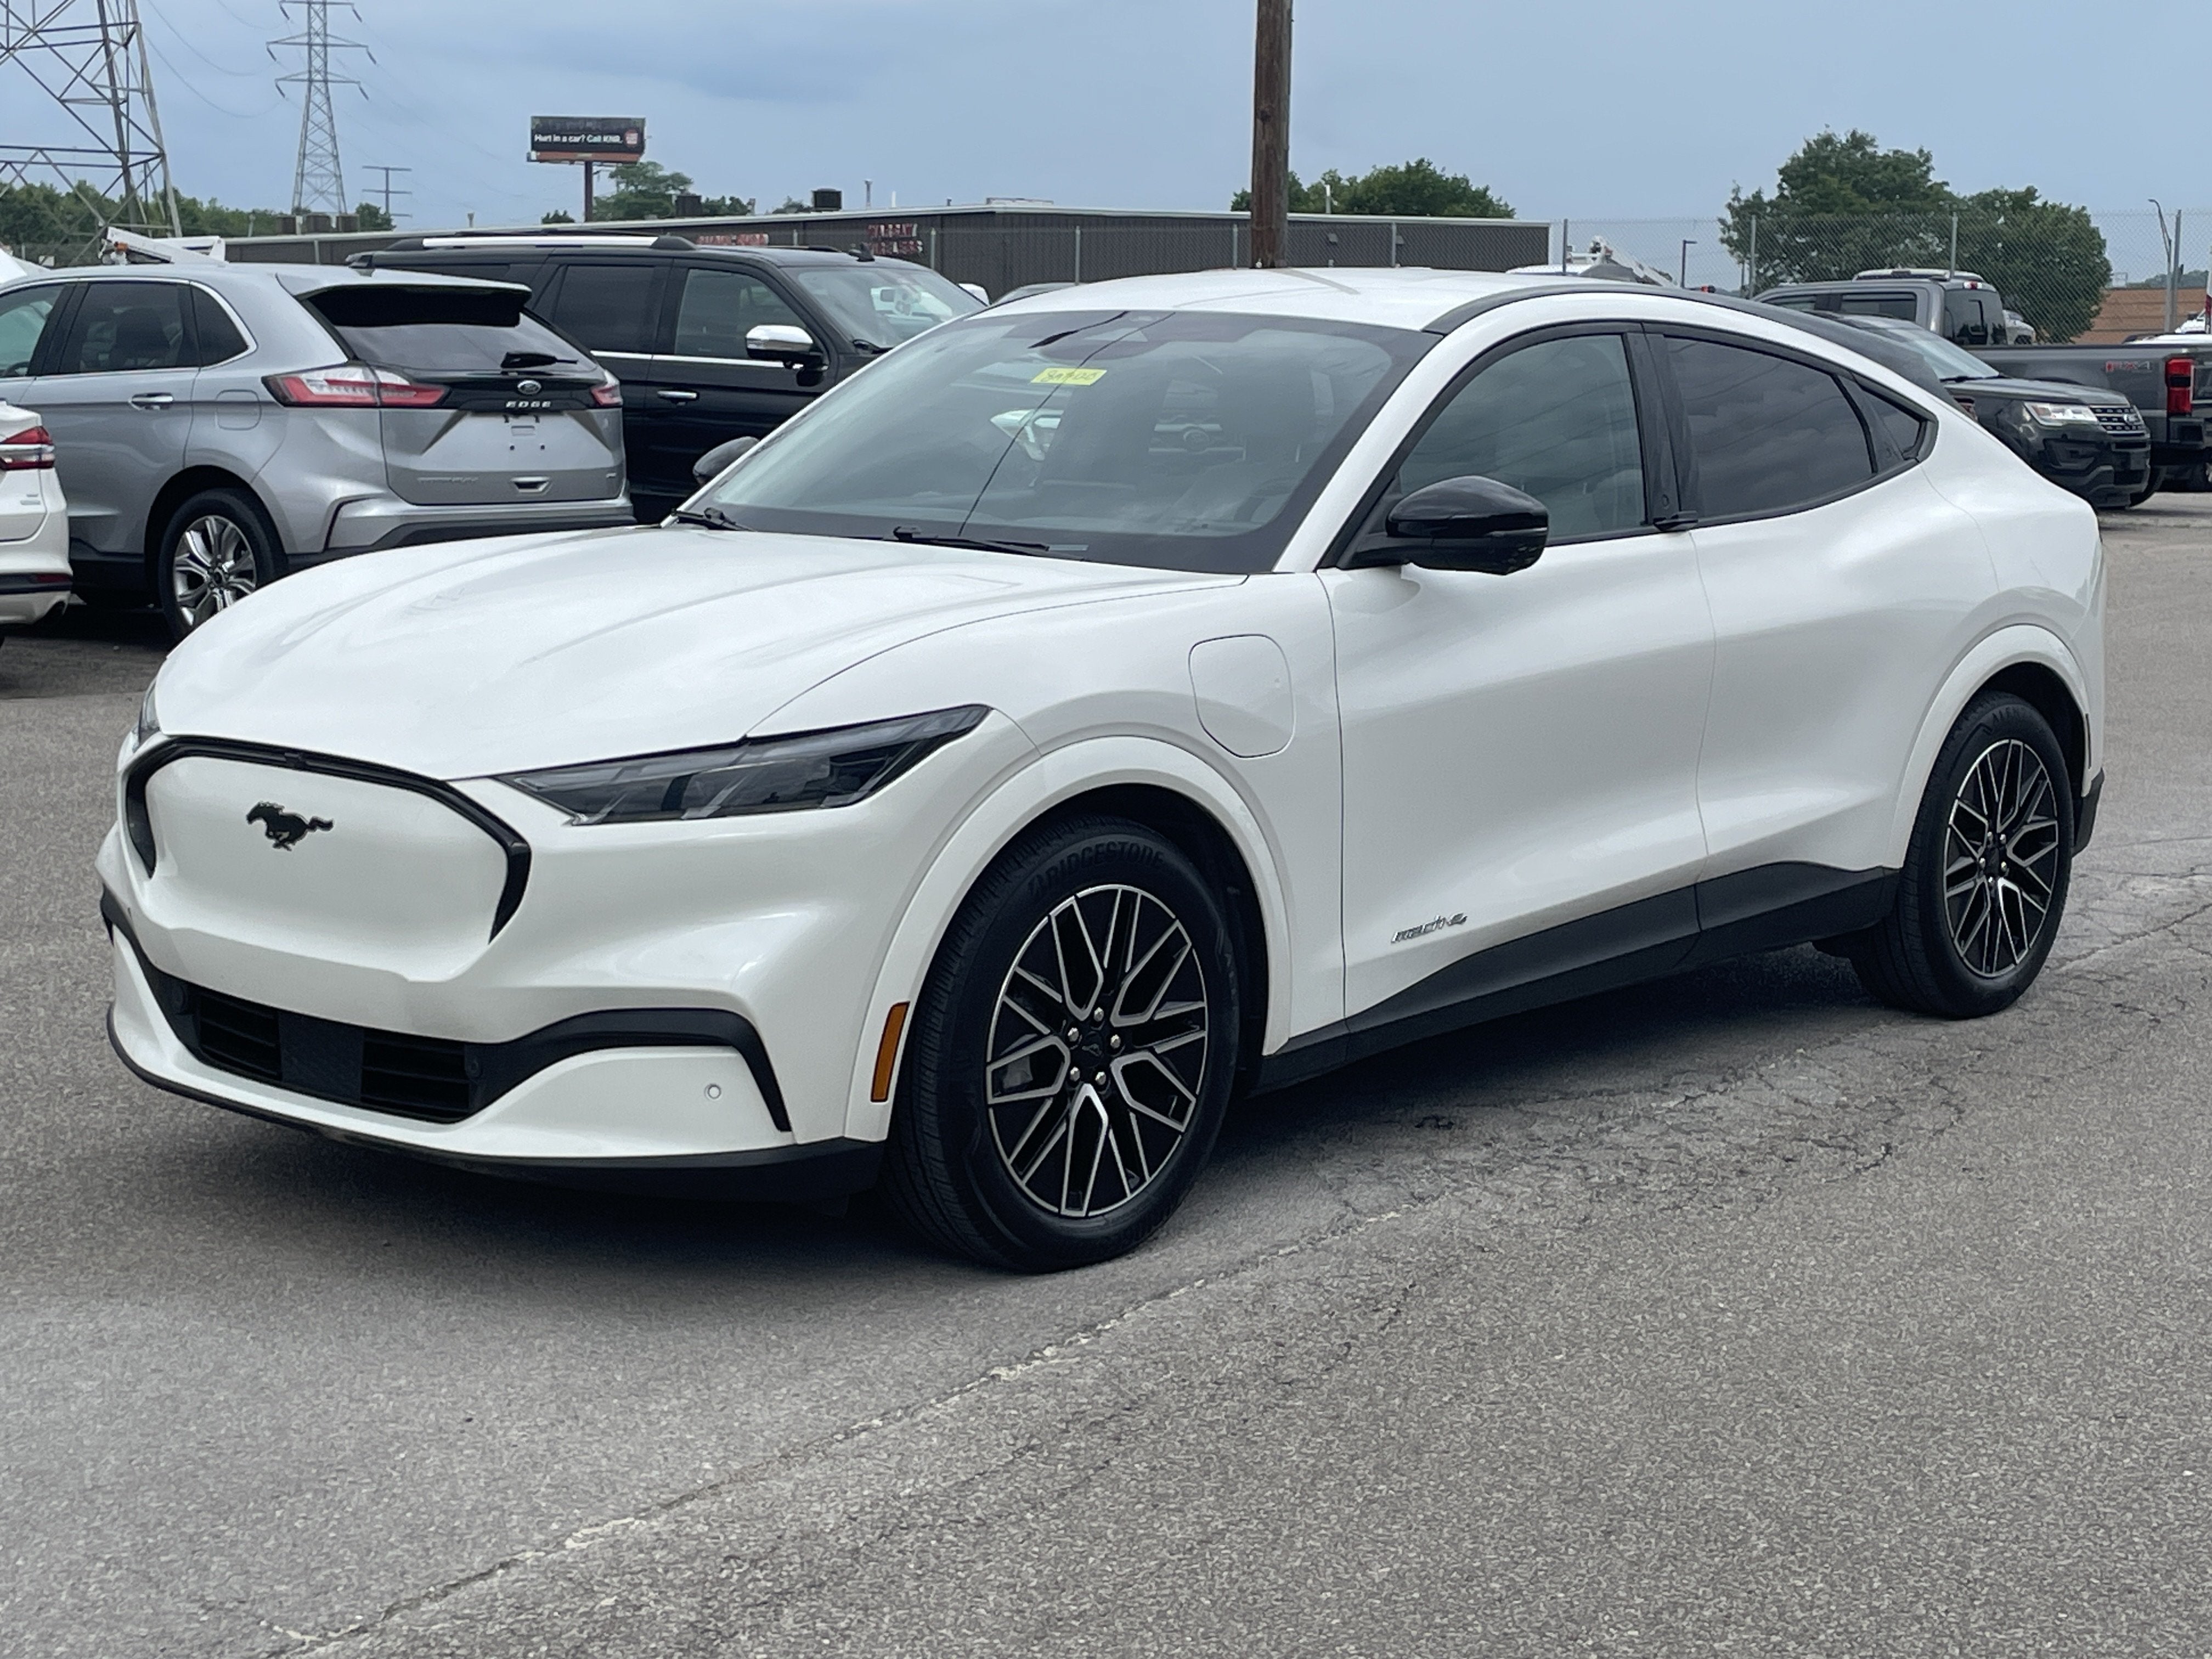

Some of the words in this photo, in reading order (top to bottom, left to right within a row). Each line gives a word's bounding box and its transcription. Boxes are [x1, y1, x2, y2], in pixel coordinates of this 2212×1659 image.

[534, 134, 552, 142] Hurt
[553, 134, 561, 142] in
[568, 134, 586, 143] car?
[586, 134, 602, 143] Call
[1028, 840, 1164, 896] BRIDGESTONE
